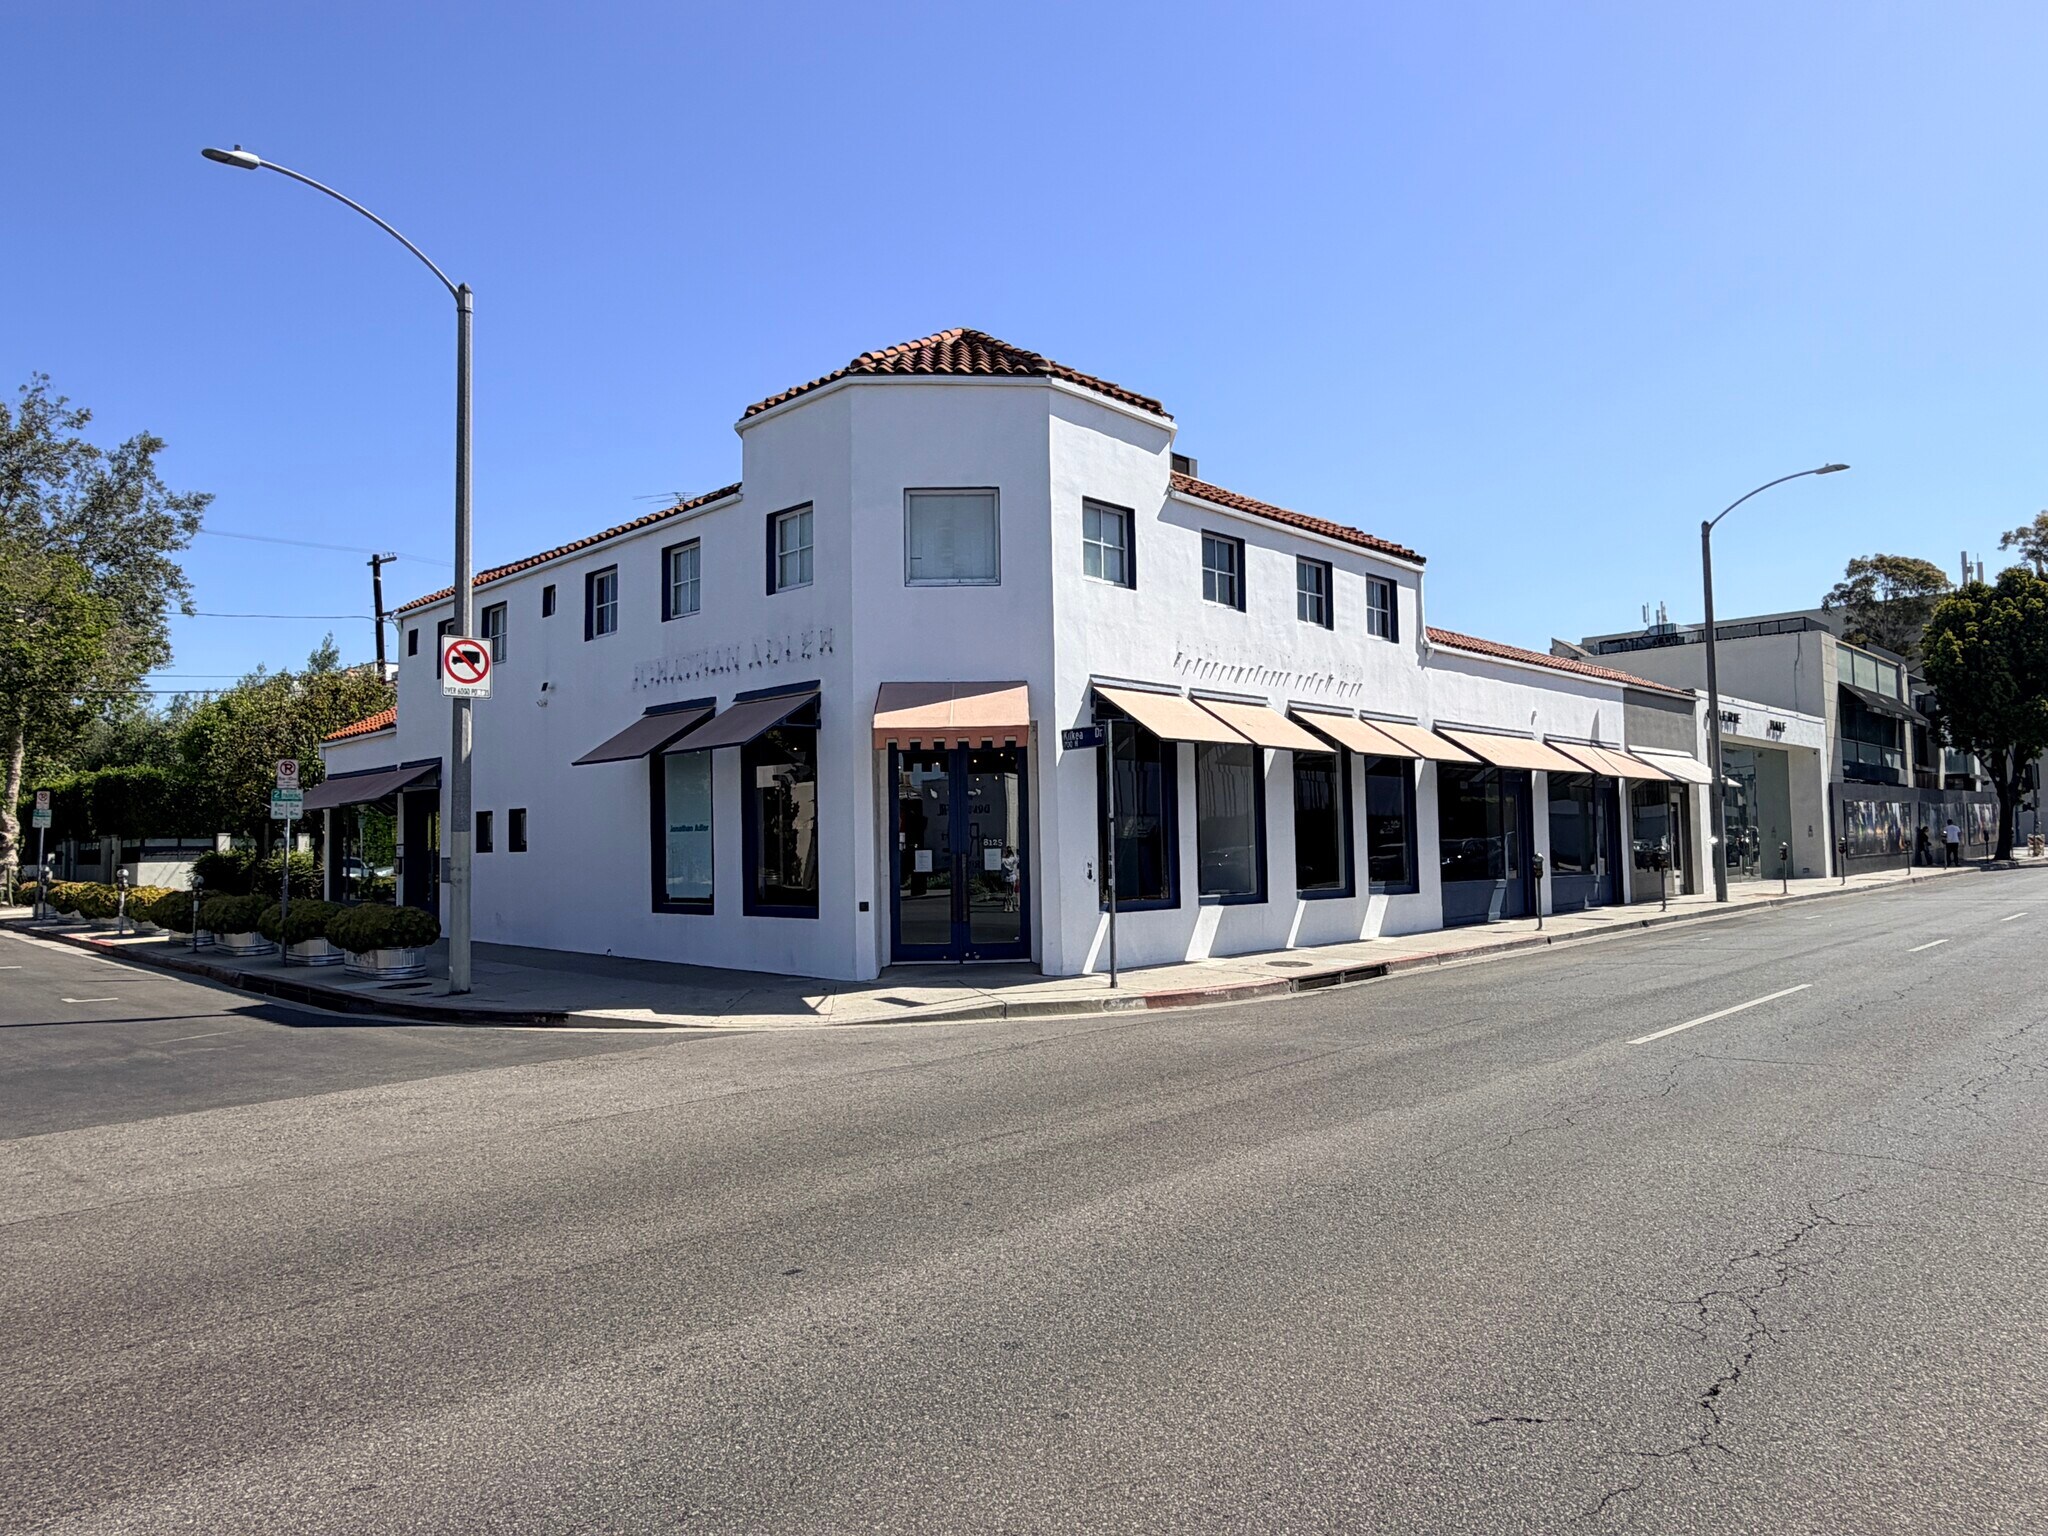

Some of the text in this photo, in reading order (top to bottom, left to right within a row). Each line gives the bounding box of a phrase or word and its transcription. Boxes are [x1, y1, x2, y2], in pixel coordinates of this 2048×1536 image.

[1063, 727, 1103, 741] Kilkea Dr
[983, 839, 1003, 847] 8125
